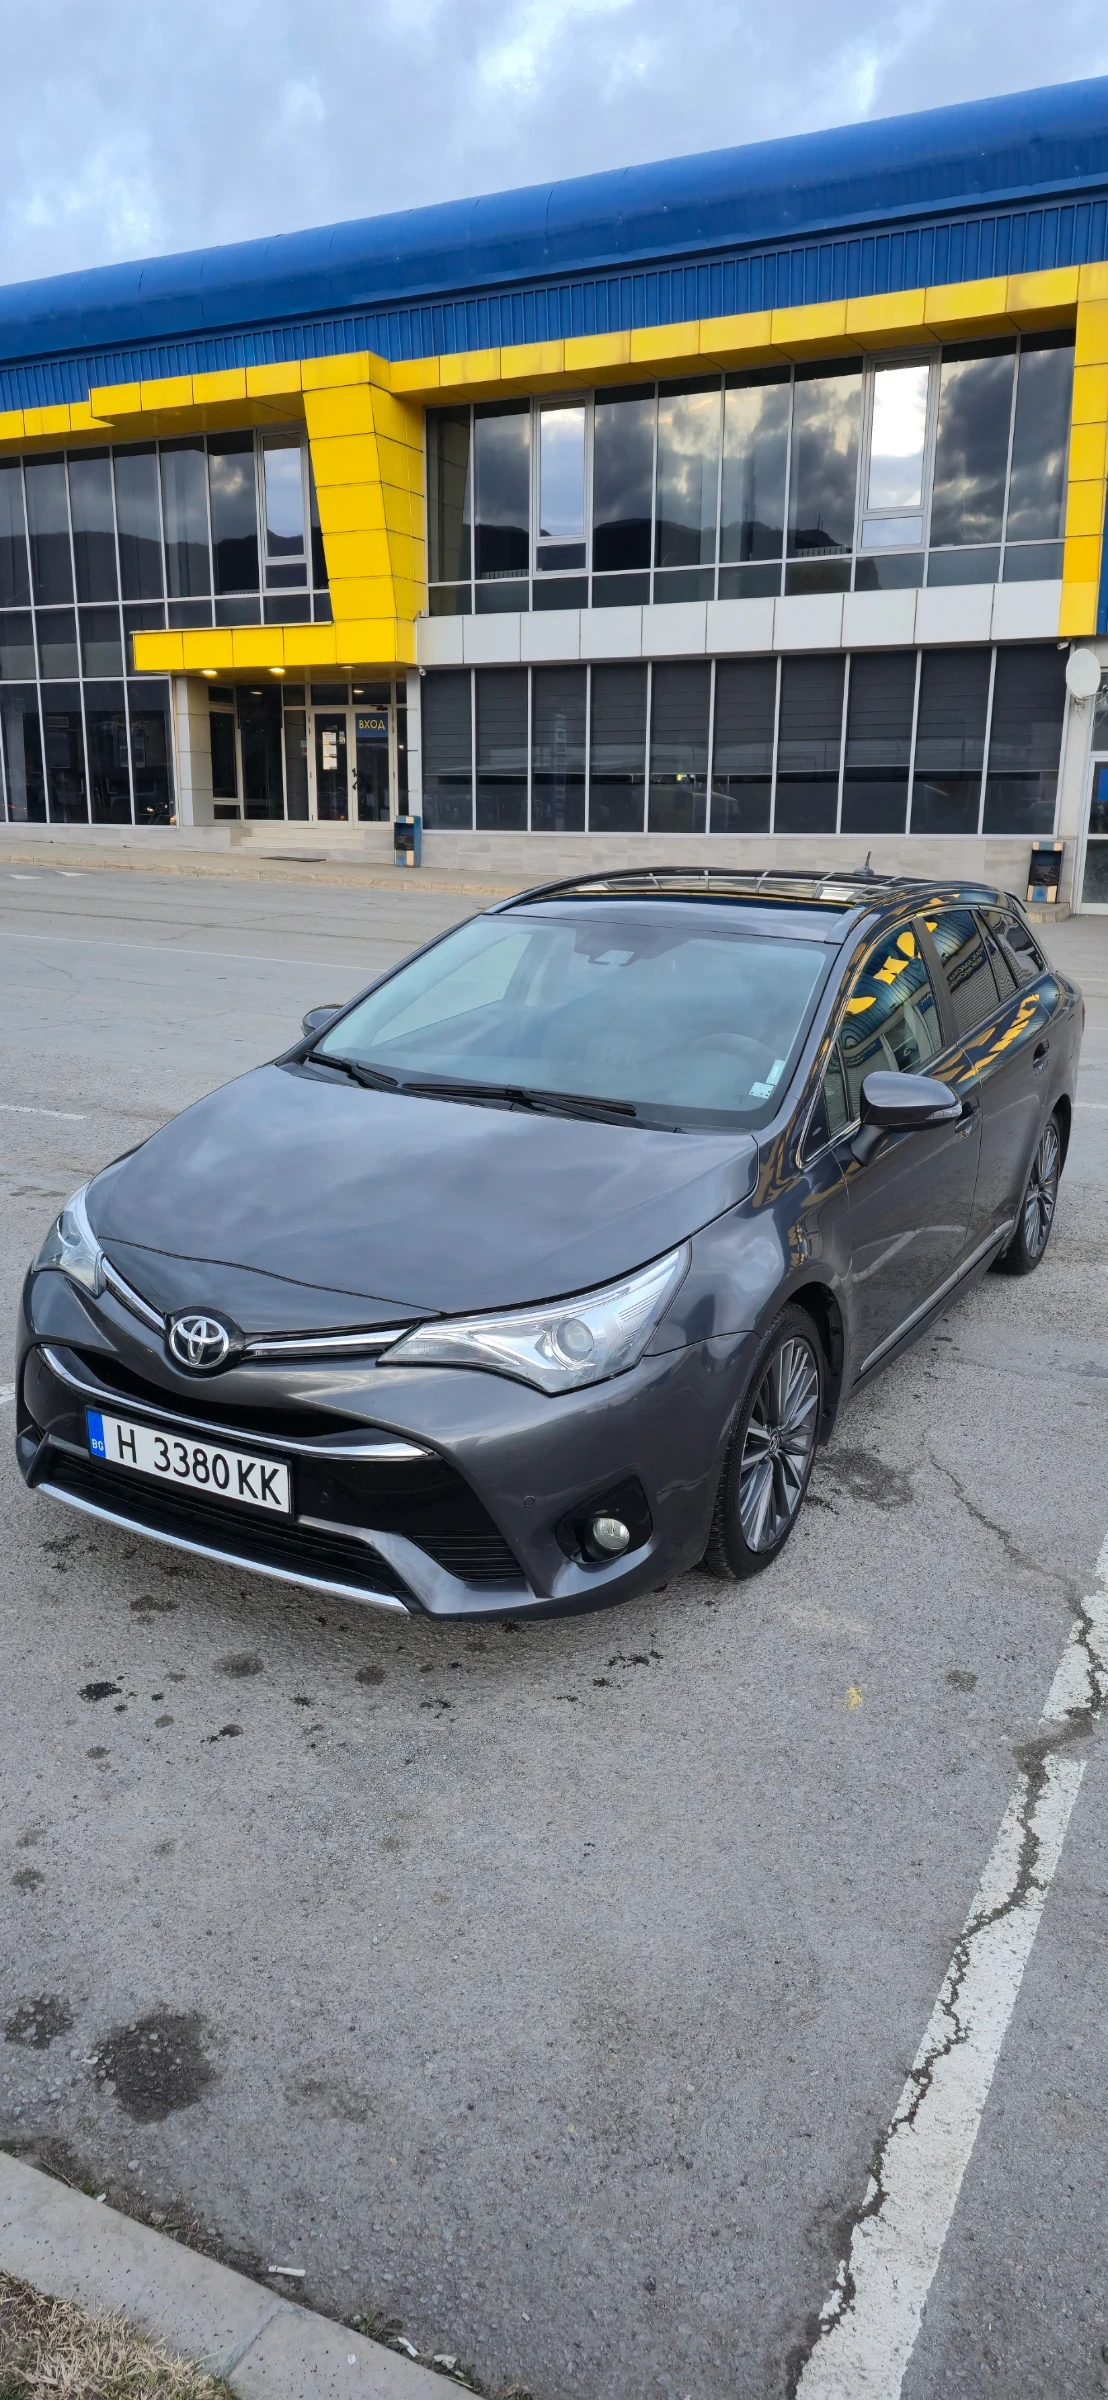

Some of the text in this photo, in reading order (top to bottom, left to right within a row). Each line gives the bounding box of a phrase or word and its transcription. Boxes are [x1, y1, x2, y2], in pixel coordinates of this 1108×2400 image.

[359, 719, 385, 730] ВХОД
[92, 1438, 104, 1451] BG
[117, 1424, 137, 1463] H
